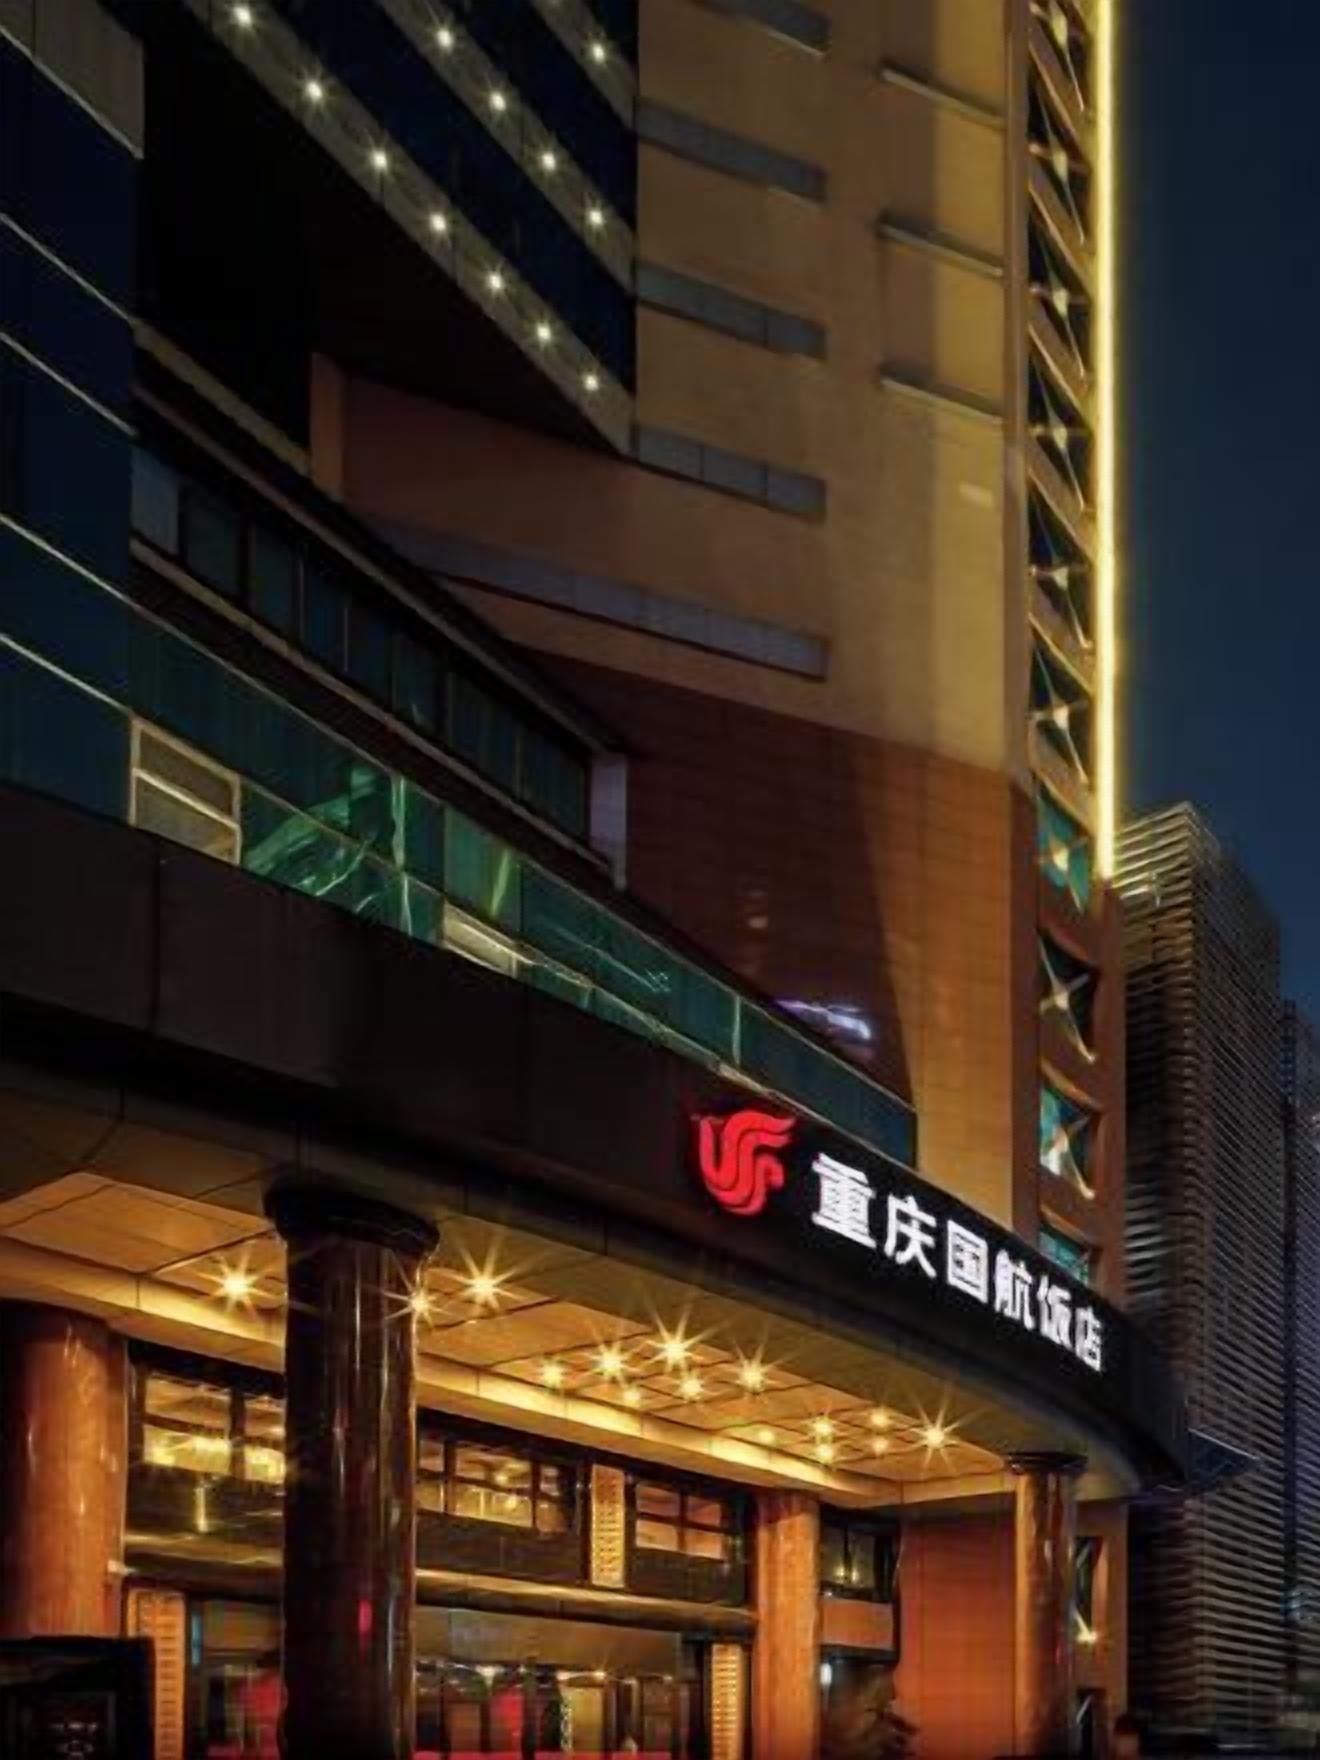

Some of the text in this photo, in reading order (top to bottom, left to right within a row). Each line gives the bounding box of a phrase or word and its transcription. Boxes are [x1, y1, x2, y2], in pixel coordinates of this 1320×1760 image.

[811, 1152, 1103, 1372] 重庆国航饭店
